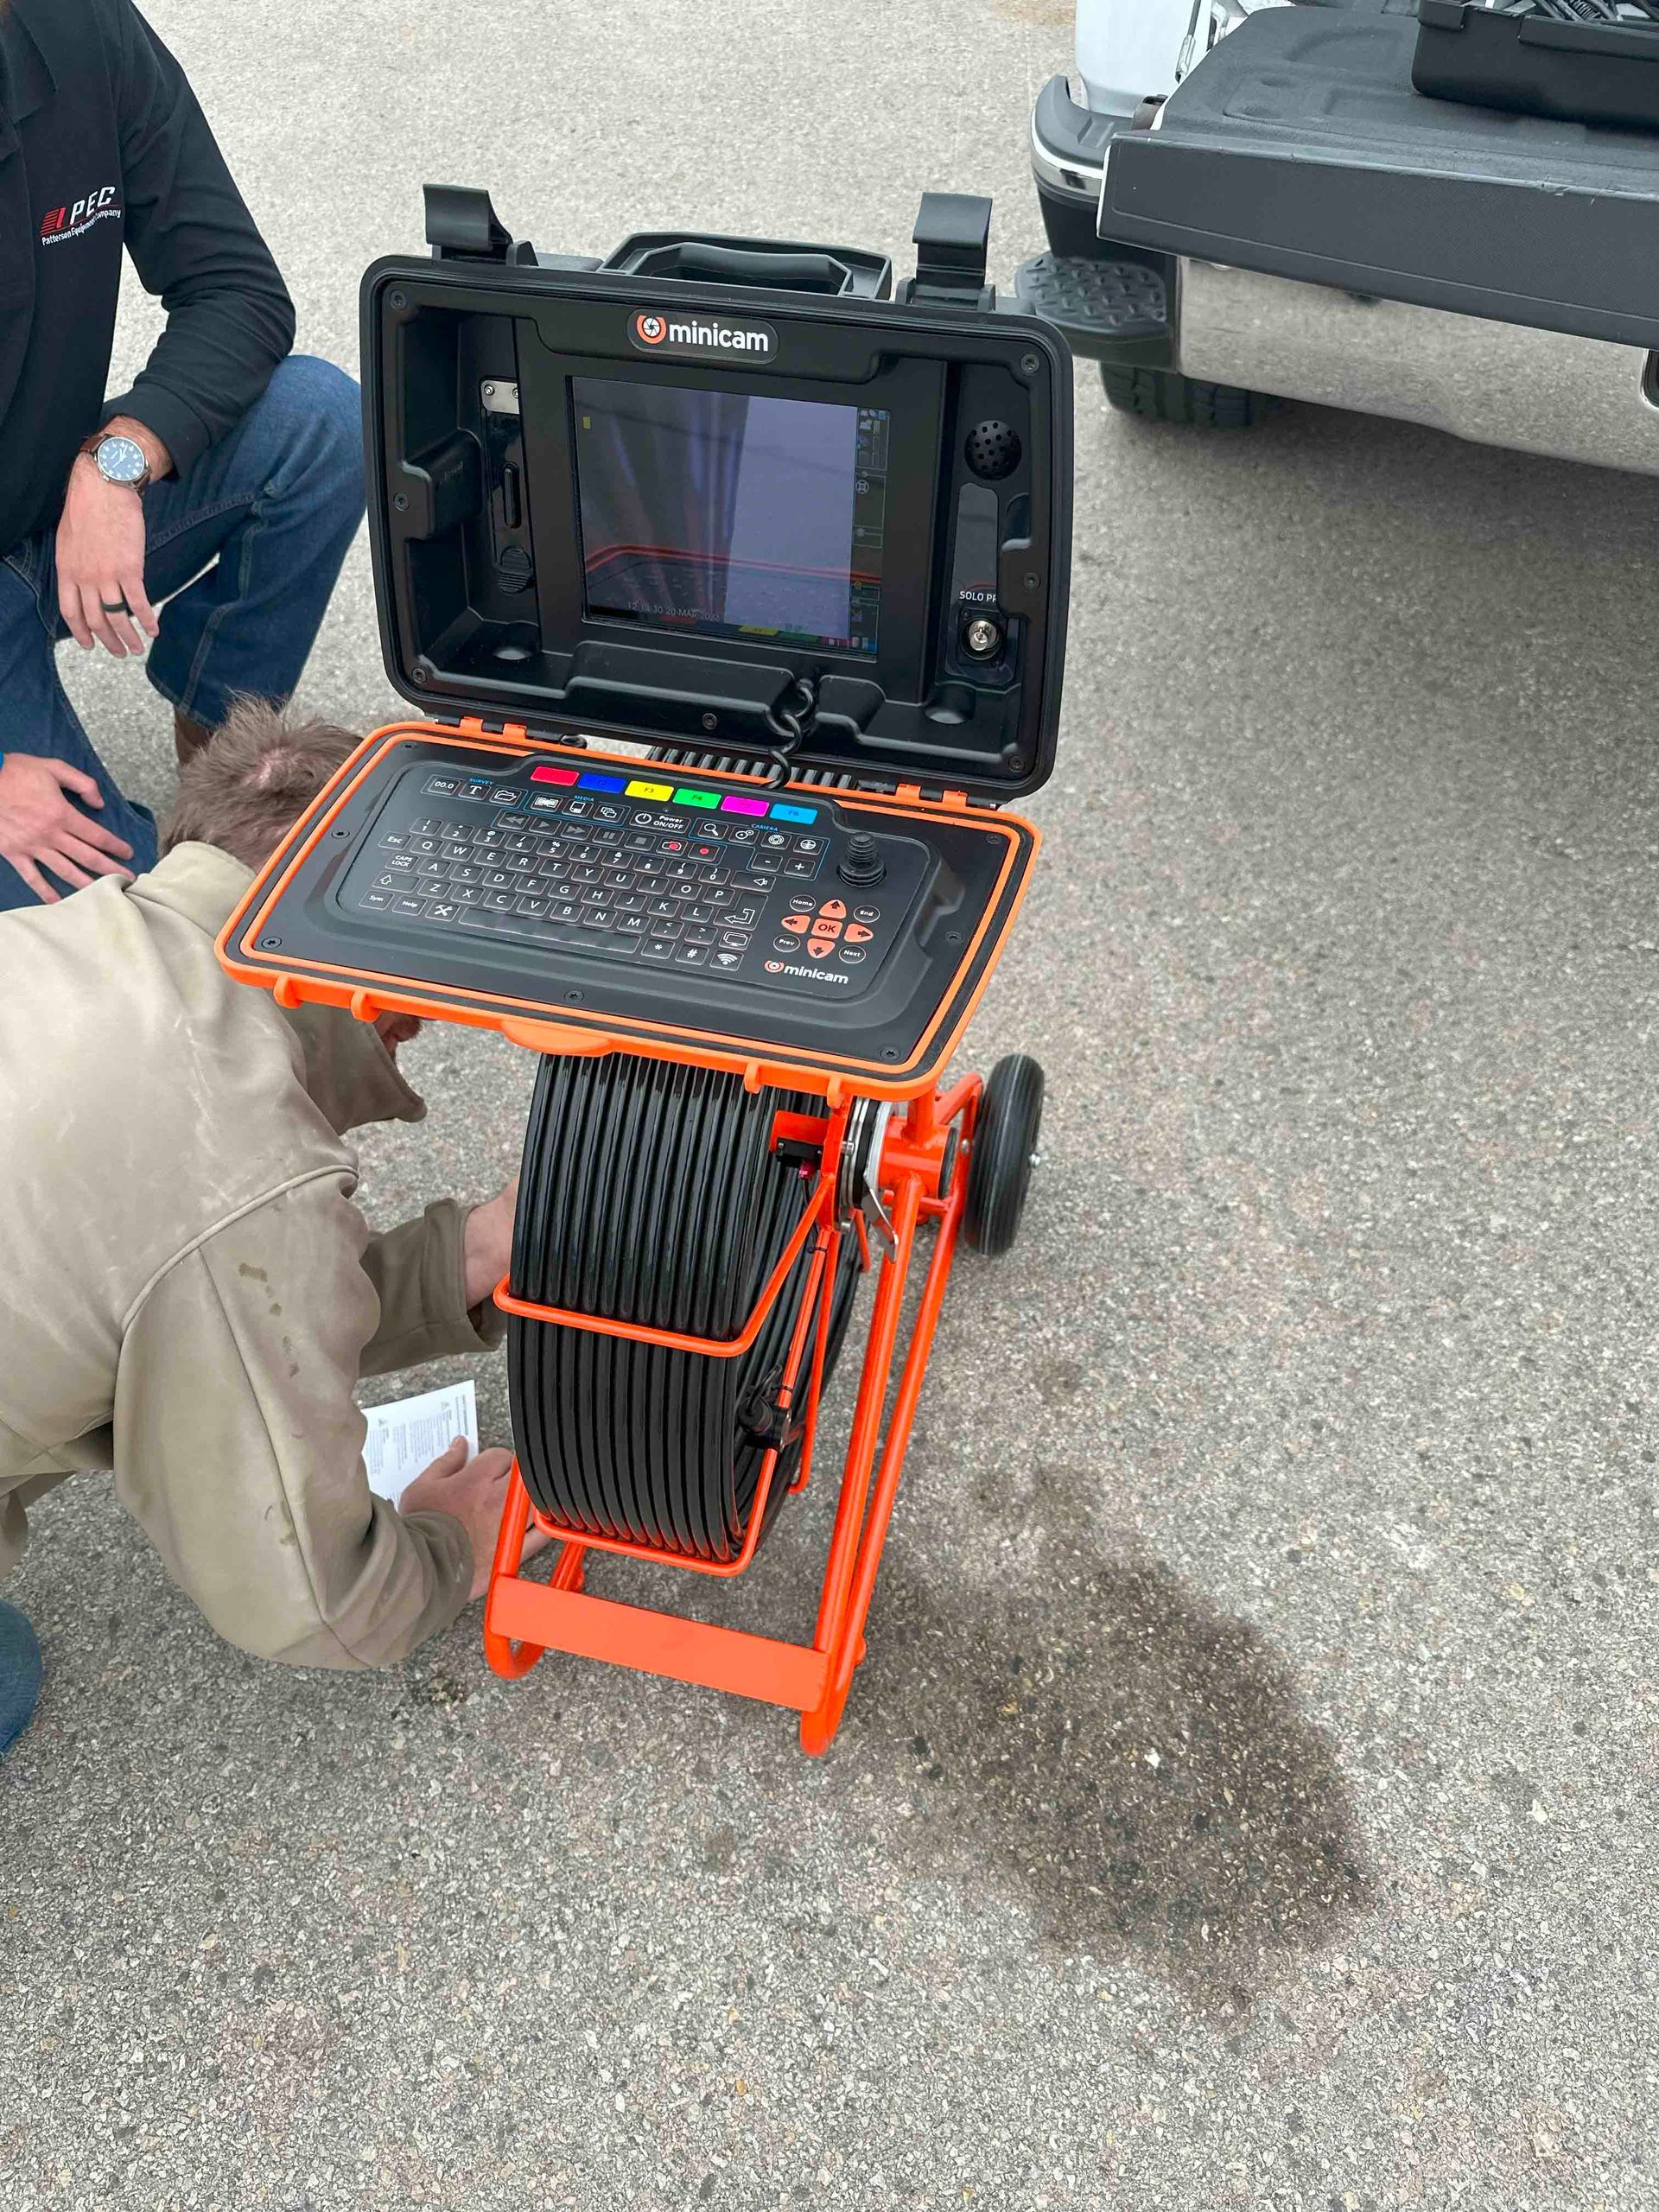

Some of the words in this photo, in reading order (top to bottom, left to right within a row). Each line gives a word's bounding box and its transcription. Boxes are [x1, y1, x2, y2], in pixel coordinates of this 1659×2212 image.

[69, 186, 116, 226] PEC
[41, 229, 72, 246] Patterson
[669, 320, 768, 352] minicam
[959, 590, 984, 601] SOLO
[469, 778, 494, 786] SURVEY
[469, 785, 482, 795] T
[573, 793, 595, 802] MEDIA
[659, 815, 683, 823] Power
[652, 818, 683, 830] ON/OFF
[750, 823, 779, 832] CAMERA
[422, 841, 433, 850] Q
[454, 846, 467, 855] W
[486, 852, 496, 861] E
[518, 857, 528, 866] R
[461, 868, 472, 877] S
[493, 874, 505, 882] D
[615, 874, 626, 882] U
[429, 883, 441, 893] Z
[559, 885, 570, 893] G
[680, 885, 692, 893] O
[462, 889, 474, 898] X
[592, 891, 603, 899] H
[496, 895, 507, 904] C
[531, 900, 540, 909] V
[658, 902, 669, 911] K
[563, 906, 572, 915] B
[692, 907, 700, 916] L
[594, 912, 607, 921] N
[626, 918, 641, 927] M
[818, 924, 836, 933] OK
[784, 965, 849, 984] minicam
